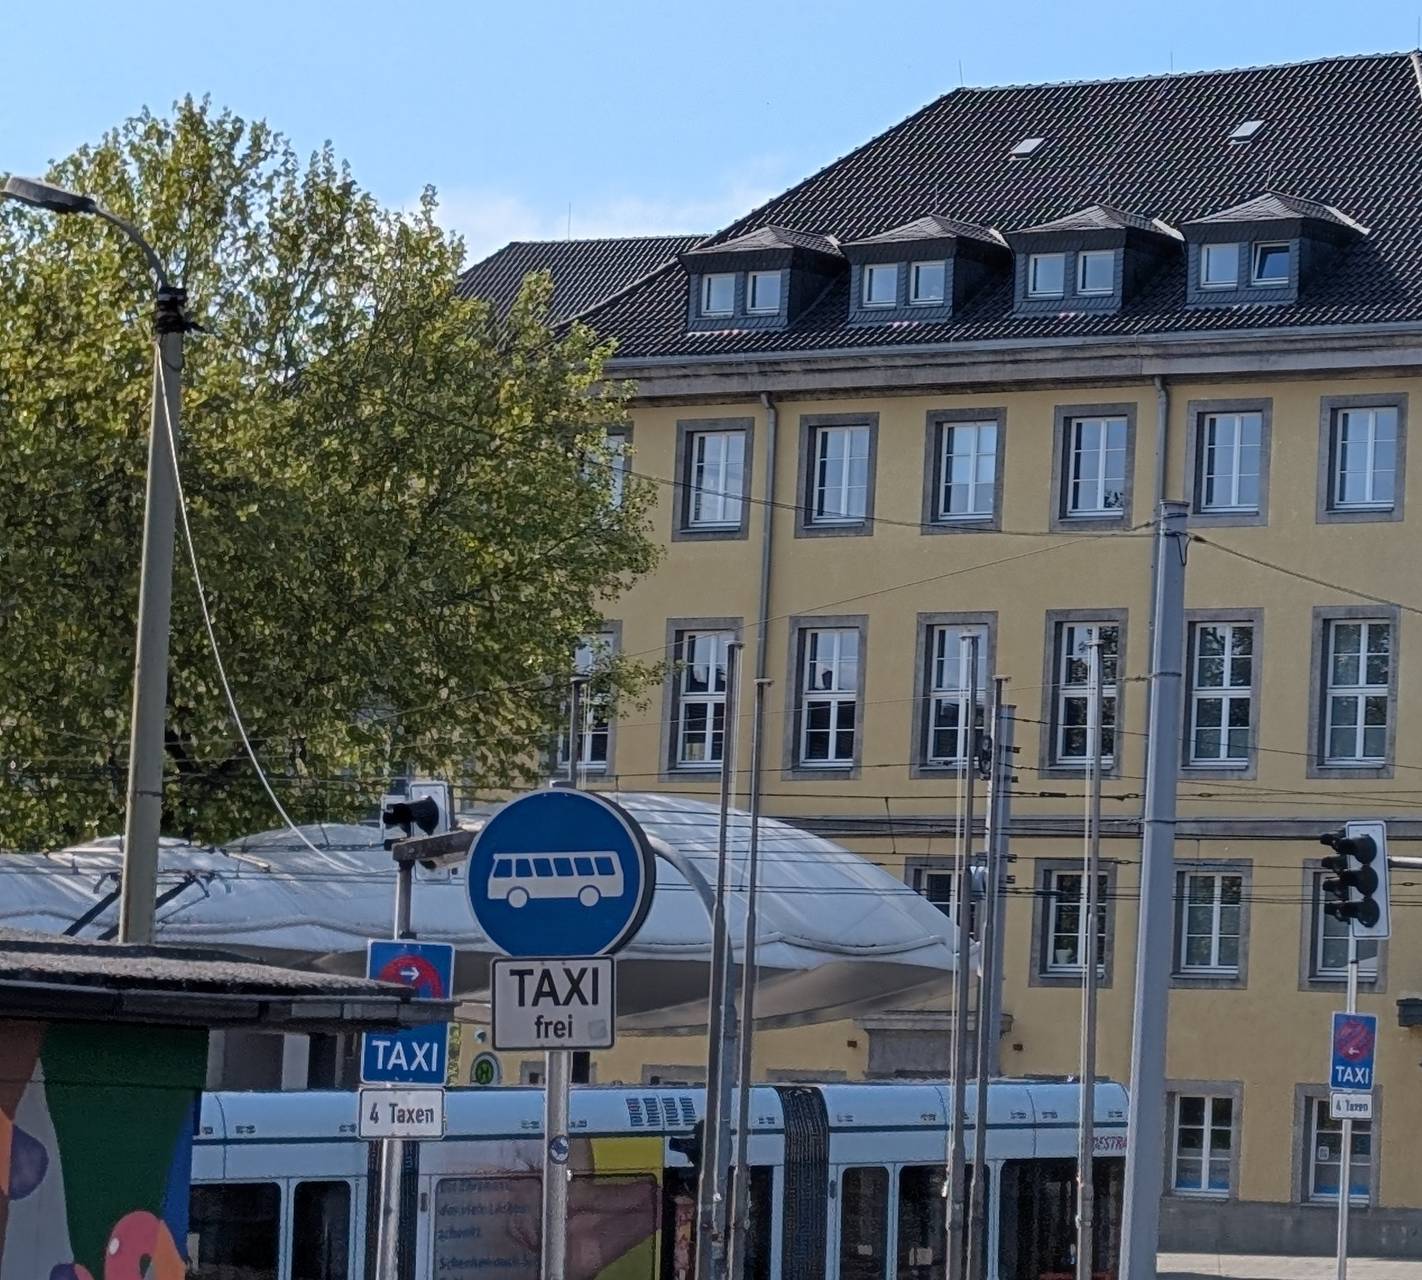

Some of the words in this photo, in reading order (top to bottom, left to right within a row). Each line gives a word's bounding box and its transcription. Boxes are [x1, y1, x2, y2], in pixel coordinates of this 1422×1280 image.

[509, 967, 599, 1007] TAXI
[535, 1014, 573, 1039] frei
[372, 1040, 438, 1072] TAXI
[1335, 1065, 1370, 1085] TAXI
[369, 1102, 380, 1124] 4
[389, 1103, 434, 1124] Taxen
